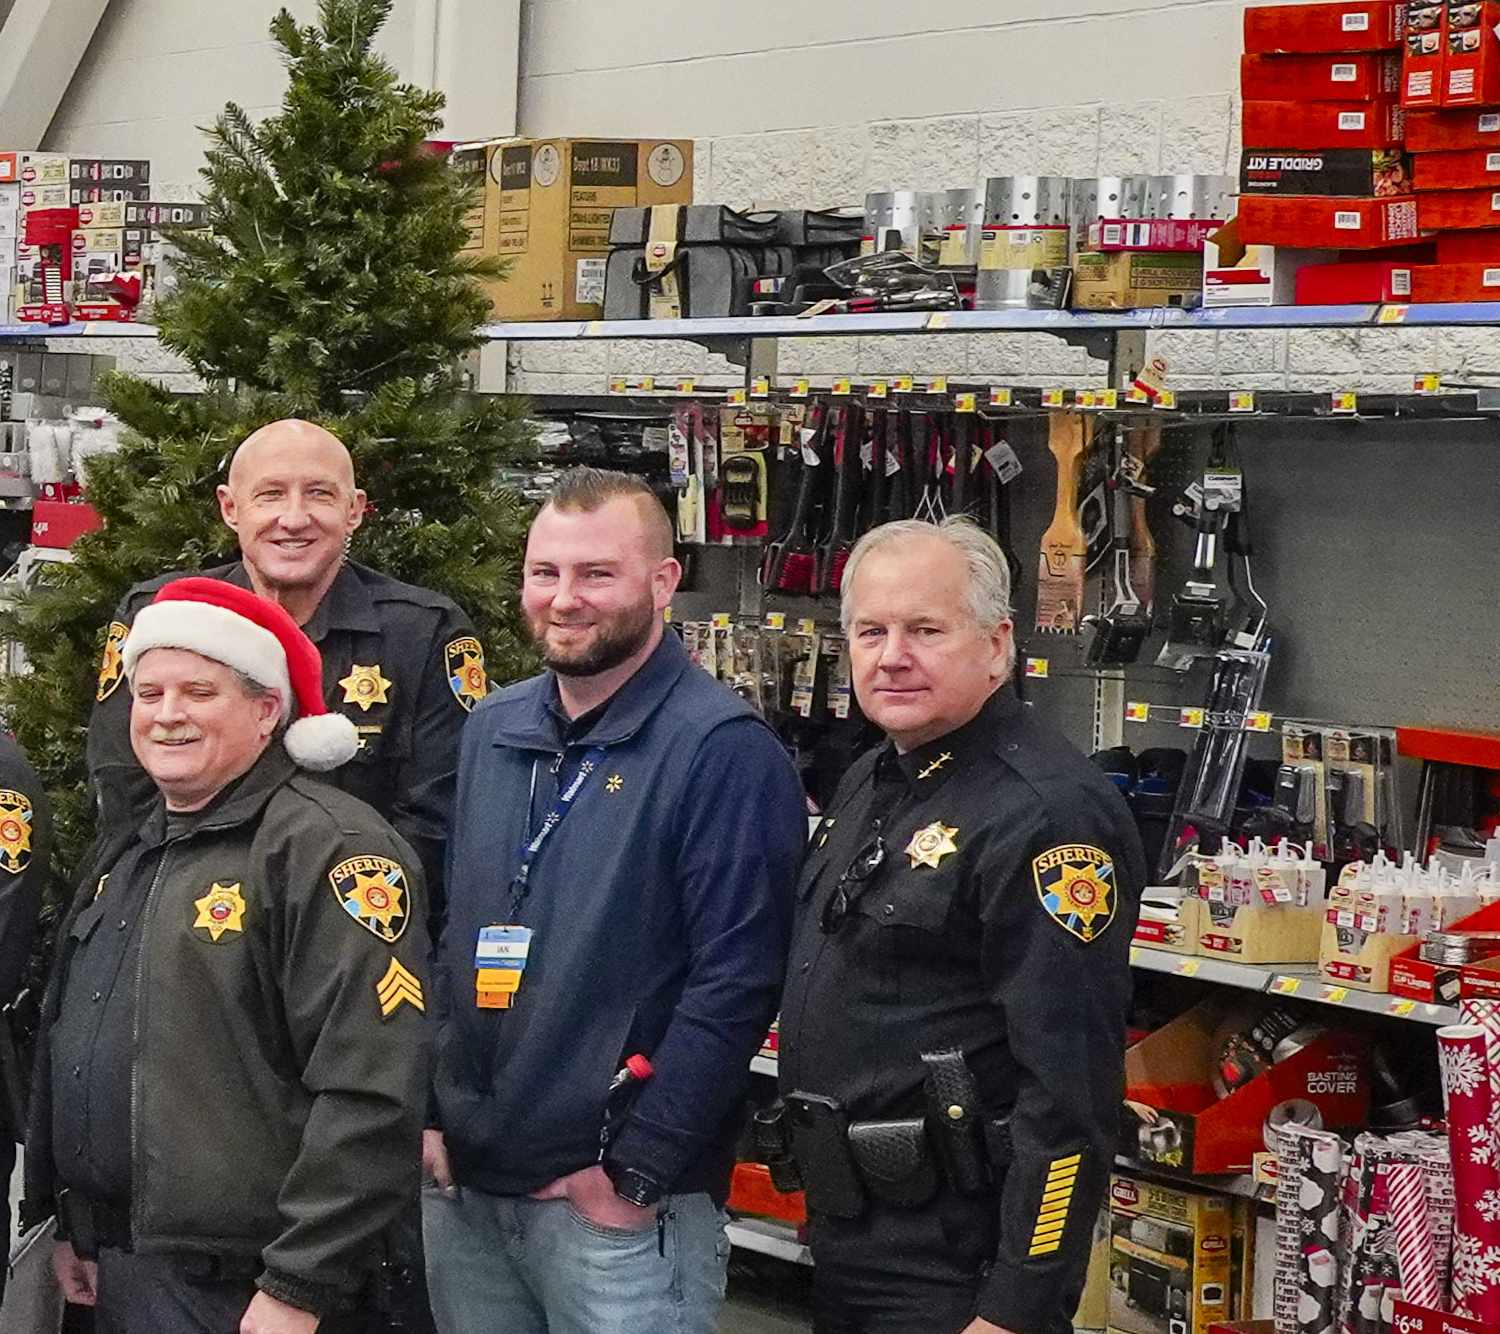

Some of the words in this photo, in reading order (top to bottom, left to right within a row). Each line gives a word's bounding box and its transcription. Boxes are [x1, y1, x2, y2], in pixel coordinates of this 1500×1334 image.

[1246, 156, 1267, 170] KIT
[1268, 157, 1324, 171] GRIDDLE
[332, 857, 402, 884] SHERIFF
[496, 945, 510, 955] IAN
[1307, 1071, 1357, 1083] BASTING
[1307, 1081, 1357, 1094] COVER
